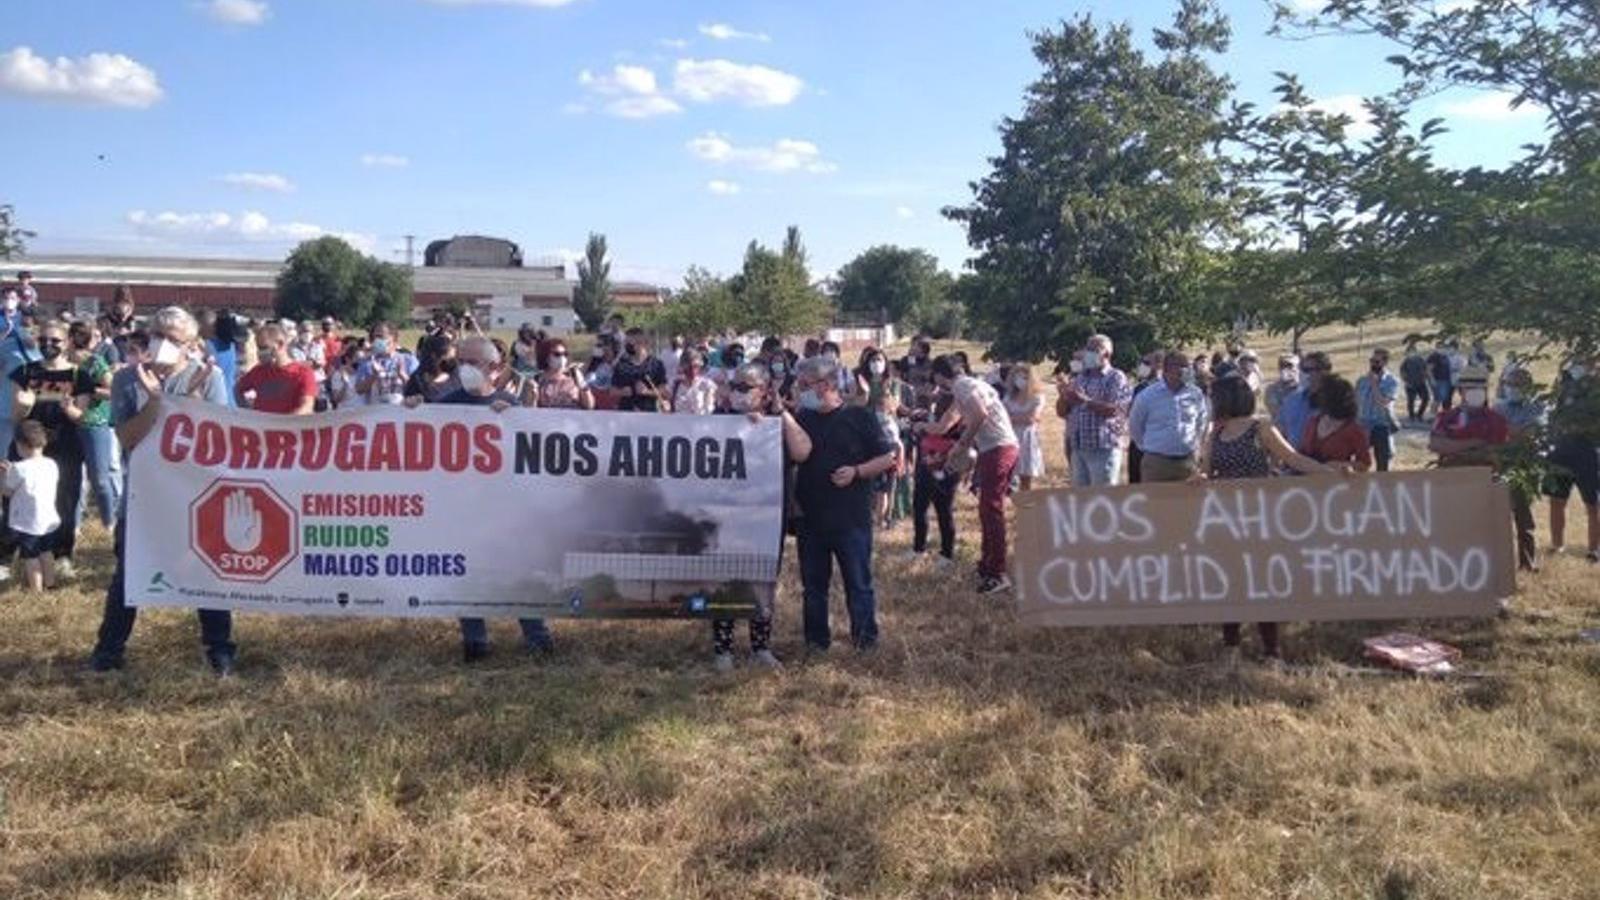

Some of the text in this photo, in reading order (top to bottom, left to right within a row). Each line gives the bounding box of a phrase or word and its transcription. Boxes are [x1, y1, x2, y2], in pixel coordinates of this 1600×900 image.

[160, 414, 747, 480] CORRUGADOS NOS AHOGA
[302, 494, 424, 517] EMISIONES
[1049, 480, 1433, 548] NOS AHOGAN
[303, 525, 389, 548] RUIDOS
[219, 552, 269, 571] STOP
[304, 553, 466, 577] MALOS OLORES
[1245, 552, 1292, 599] LO
